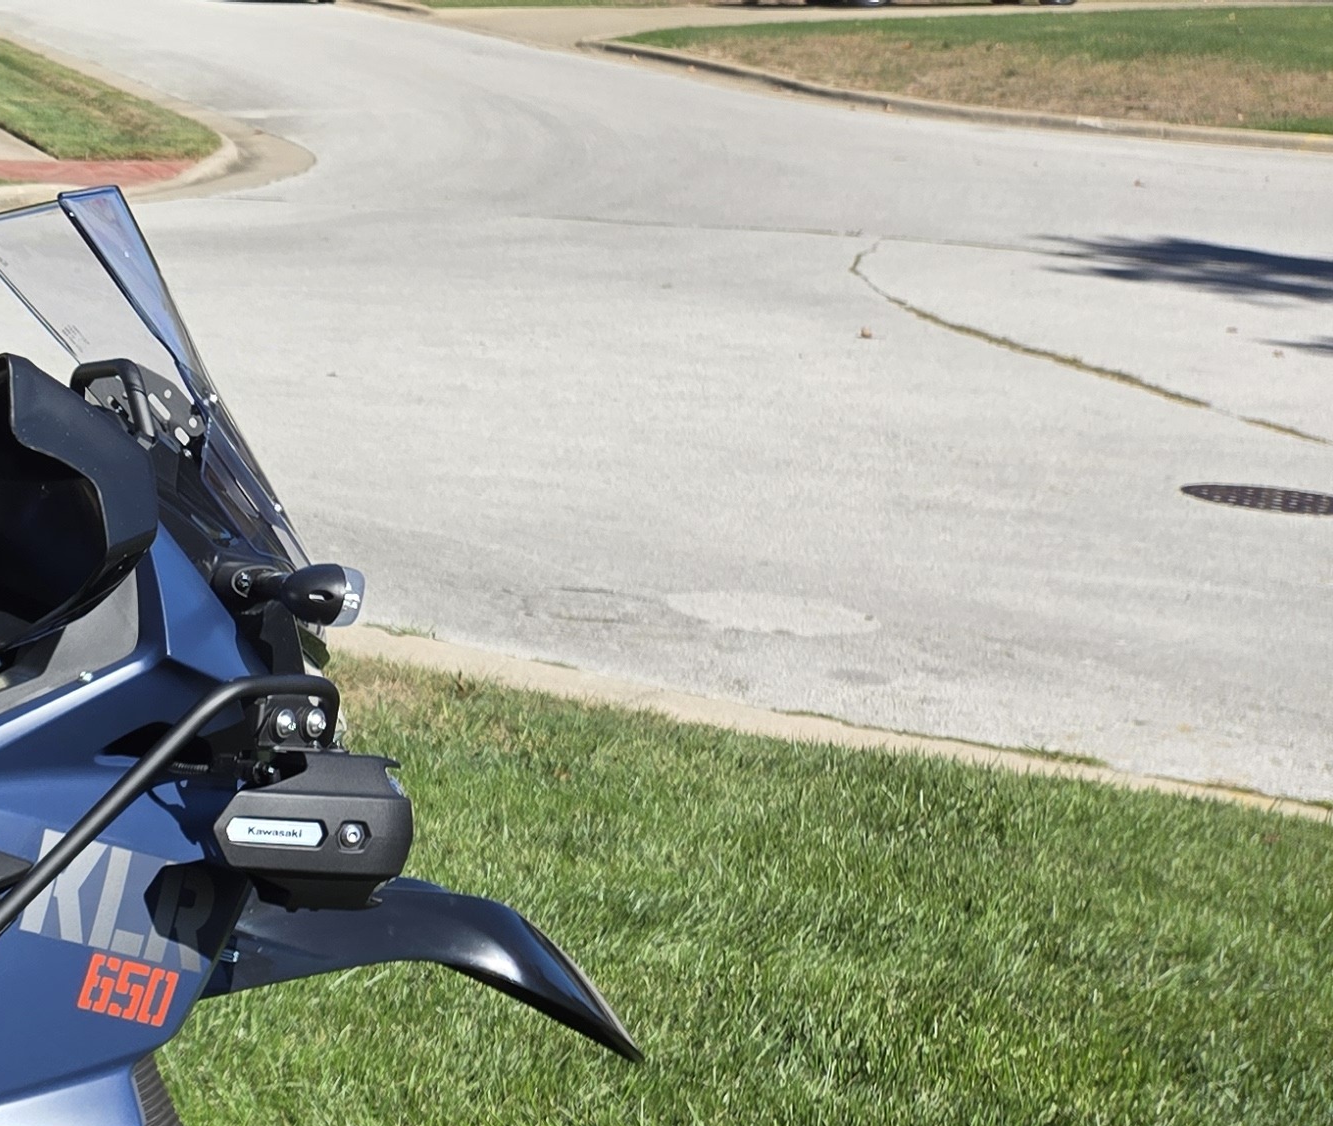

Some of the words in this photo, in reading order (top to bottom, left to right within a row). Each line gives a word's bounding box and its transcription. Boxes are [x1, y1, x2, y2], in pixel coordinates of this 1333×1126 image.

[247, 826, 303, 838] Kawasaki
[19, 828, 215, 973] KLR
[77, 953, 179, 1028] 650
